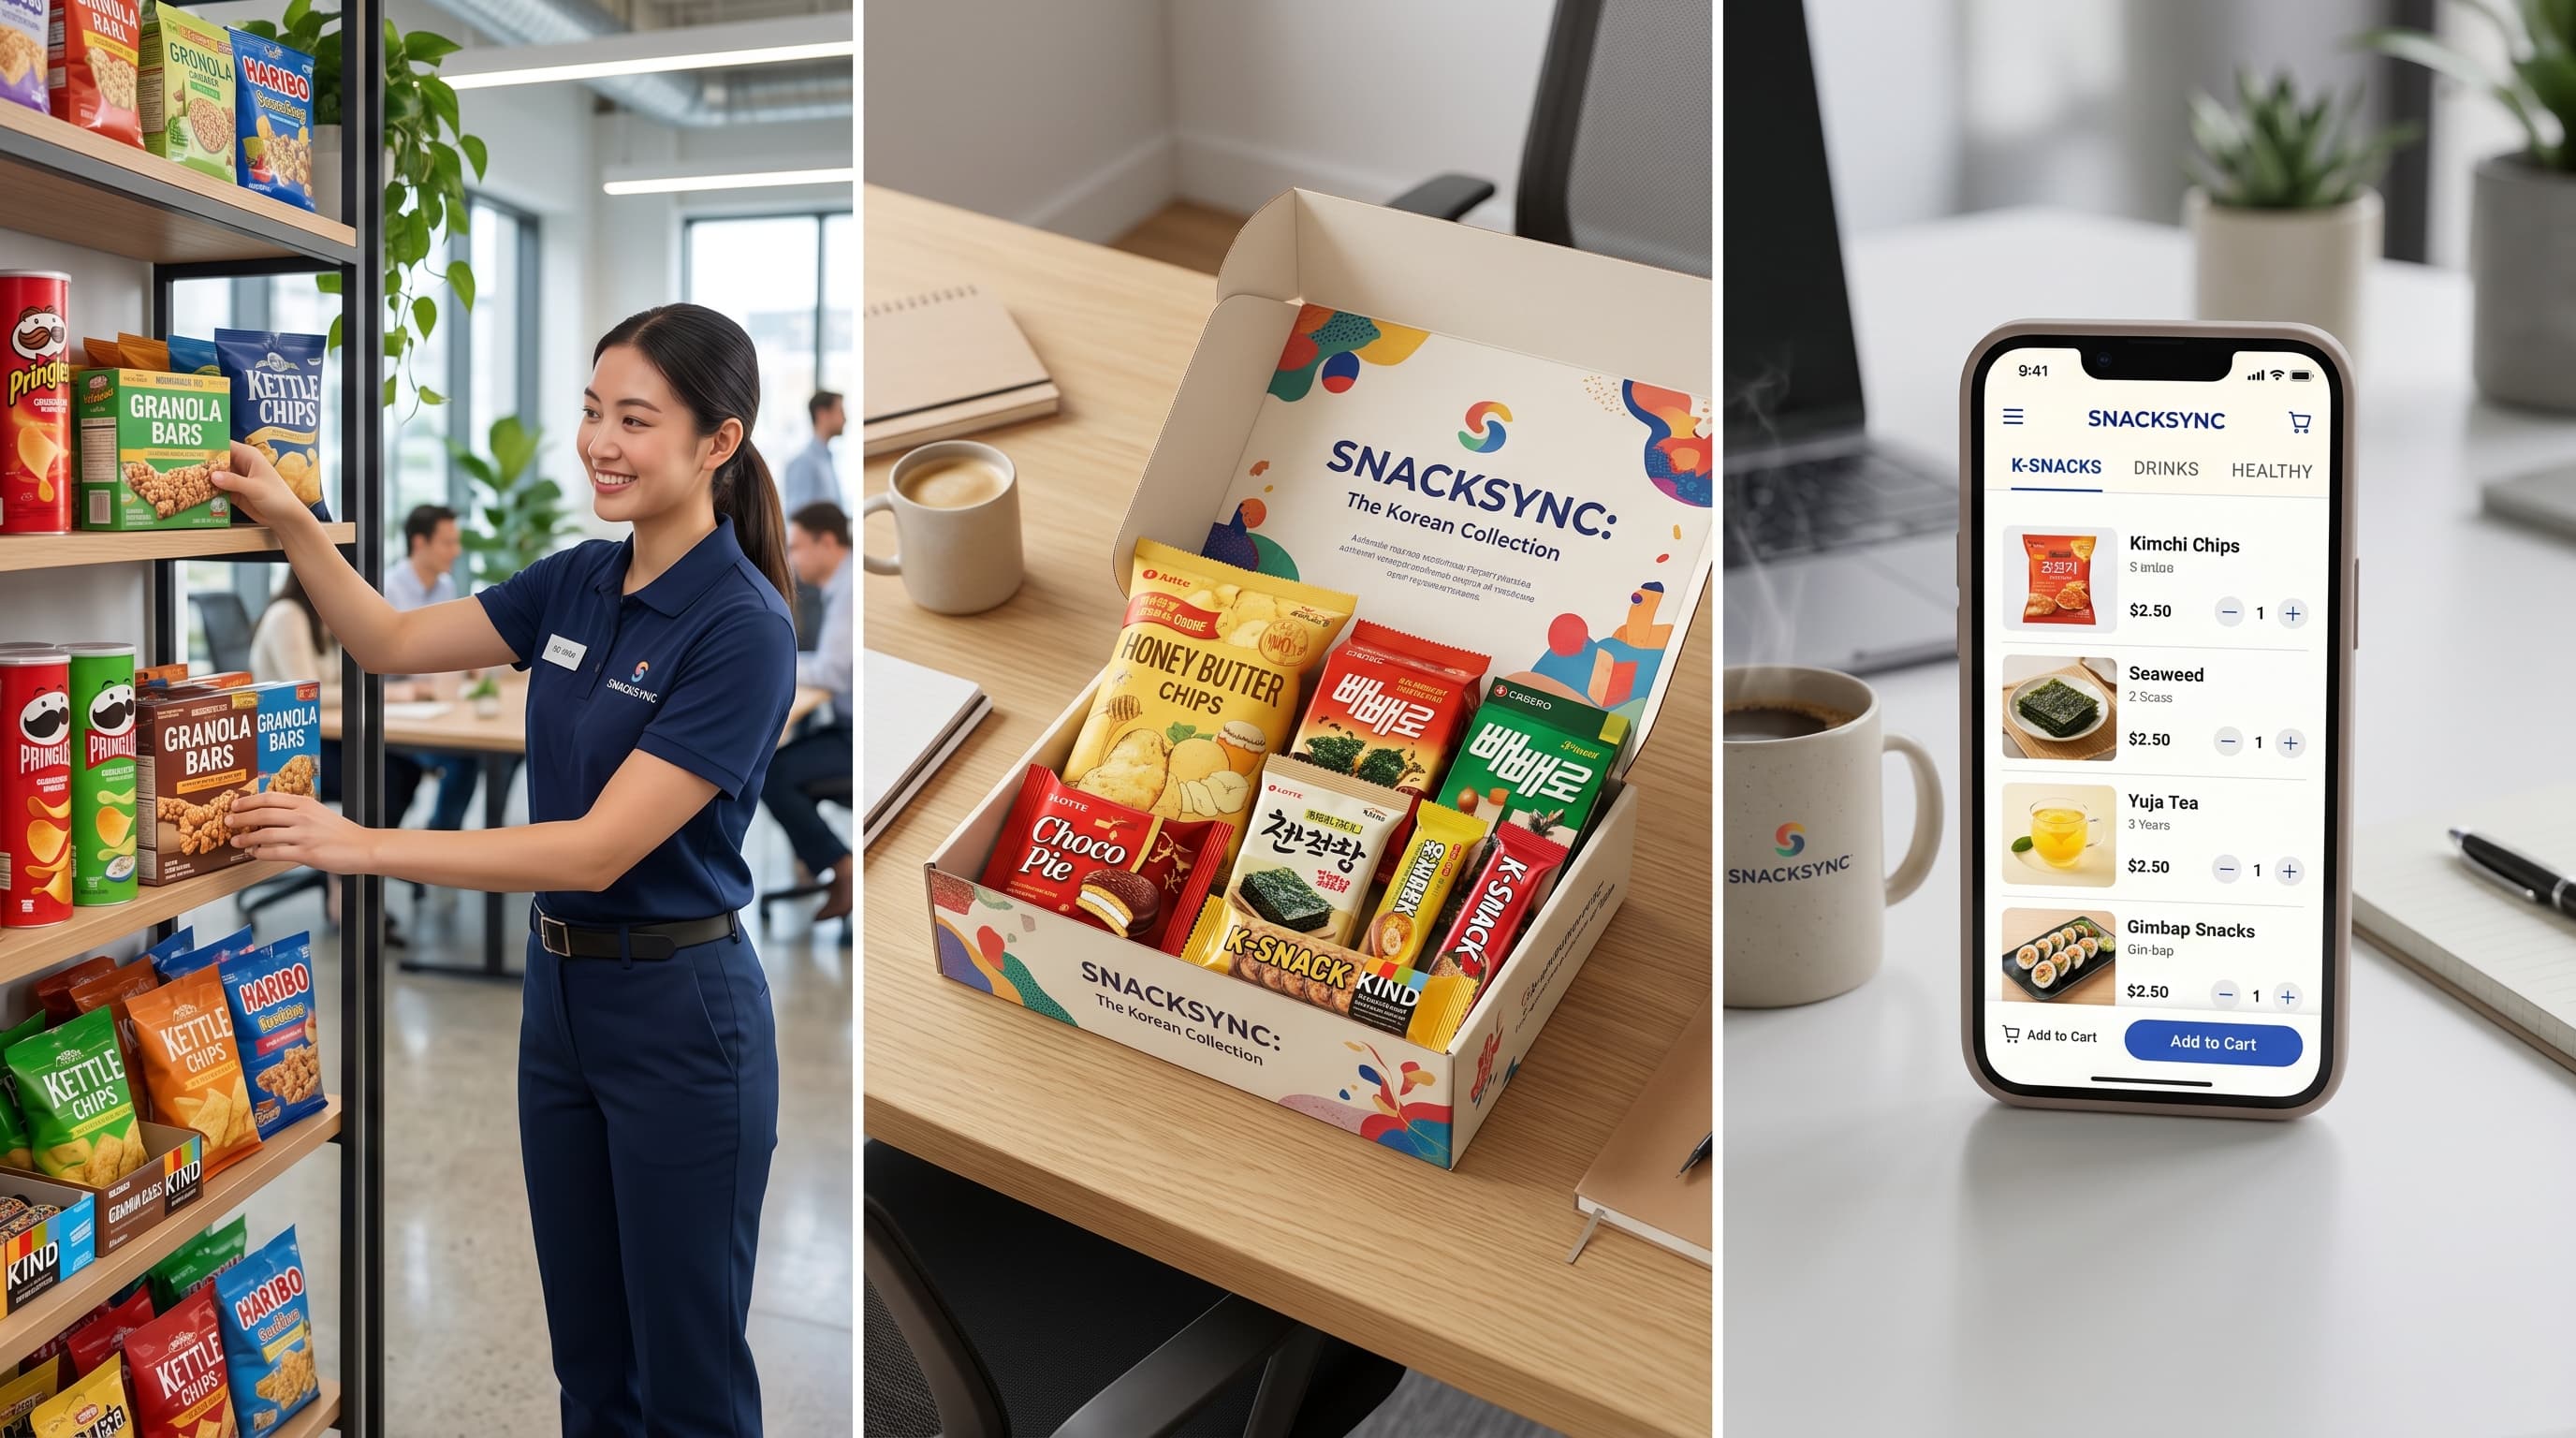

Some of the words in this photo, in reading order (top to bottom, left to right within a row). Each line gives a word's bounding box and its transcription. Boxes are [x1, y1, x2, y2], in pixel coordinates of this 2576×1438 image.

[242, 56, 310, 102] HARIBO
[2018, 364, 2048, 376] 9:41
[245, 370, 319, 401] KETTLE
[130, 394, 223, 422] GRANOLA
[260, 400, 316, 427] CHIPS
[2088, 410, 2226, 430] SNACKSYNC
[152, 421, 202, 446] BARS
[2011, 458, 2102, 475] K-SNACKS
[2134, 461, 2199, 477] DRINKS
[2232, 463, 2313, 479] HEALTHY
[1325, 440, 1617, 540] SNACKSYNC:
[1347, 492, 1382, 516] The
[1385, 503, 1455, 536] Korean
[1461, 522, 1560, 562] Collection
[2130, 536, 2188, 552] Kimchi
[2192, 537, 2241, 555] Chips
[2130, 603, 2172, 619] $2.50
[2257, 607, 2264, 620] 1
[1120, 631, 1200, 677] HONEY
[1196, 653, 1284, 709] BUTTER
[2129, 666, 2204, 682] Seaweed
[607, 678, 658, 704] SNACKSYNC
[1159, 681, 1223, 715] CHIPS
[2129, 691, 2137, 702] 2
[2140, 691, 2173, 703] Scass
[257, 706, 317, 733] GRANOLA
[1331, 673, 1436, 740] 빼빼로
[165, 714, 251, 752] GRANOLA
[269, 729, 305, 752] BARS
[2129, 732, 2171, 748] $2.50
[2255, 736, 2262, 749] 1
[185, 744, 234, 775] BARS
[1469, 722, 1593, 804] 빼빼로
[1278, 787, 1303, 800] LOTTE
[2128, 794, 2164, 812] Yuja
[2169, 796, 2199, 811] Tea
[2128, 819, 2135, 830] 3
[2139, 819, 2171, 831] Years
[1032, 815, 1126, 864] Choco
[1018, 845, 1073, 881] Pie
[1728, 855, 1851, 884] SNACKSYNC
[2128, 859, 2170, 875] $2.50
[2253, 863, 2261, 876] 1
[1455, 855, 1528, 963] K-SNACK
[2128, 919, 2190, 939] Gimbap
[2195, 922, 2256, 938] Snacks
[1224, 924, 1354, 990] K-SNACK
[2128, 944, 2174, 958] Gin-bap
[239, 962, 310, 1015] HARIBO
[1356, 971, 1420, 1006] KIND
[2127, 984, 2169, 1000] $2.50
[2253, 989, 2260, 1003] 1
[1081, 961, 1281, 1051] SNACKSYNC:
[160, 1005, 233, 1063] KETTLE
[1095, 993, 1123, 1013] The
[1128, 1005, 1181, 1035] Korean
[1185, 1028, 1263, 1065] Collection
[2027, 1029, 2052, 1041] Add
[2056, 1031, 2067, 1041] to
[2071, 1031, 2097, 1043] Cart
[2171, 1034, 2200, 1049] Add
[2204, 1036, 2219, 1049] to
[2224, 1036, 2257, 1051] Cart
[186, 1042, 227, 1073] CHIPS
[43, 1049, 125, 1108] KETTLE
[73, 1086, 119, 1121] CHIPS
[165, 1160, 200, 1196] KIND
[7, 1241, 58, 1291] KIND
[236, 1266, 304, 1330] HARIBO
[155, 1331, 224, 1400] KETTLE
[181, 1370, 218, 1406] CHIPS
